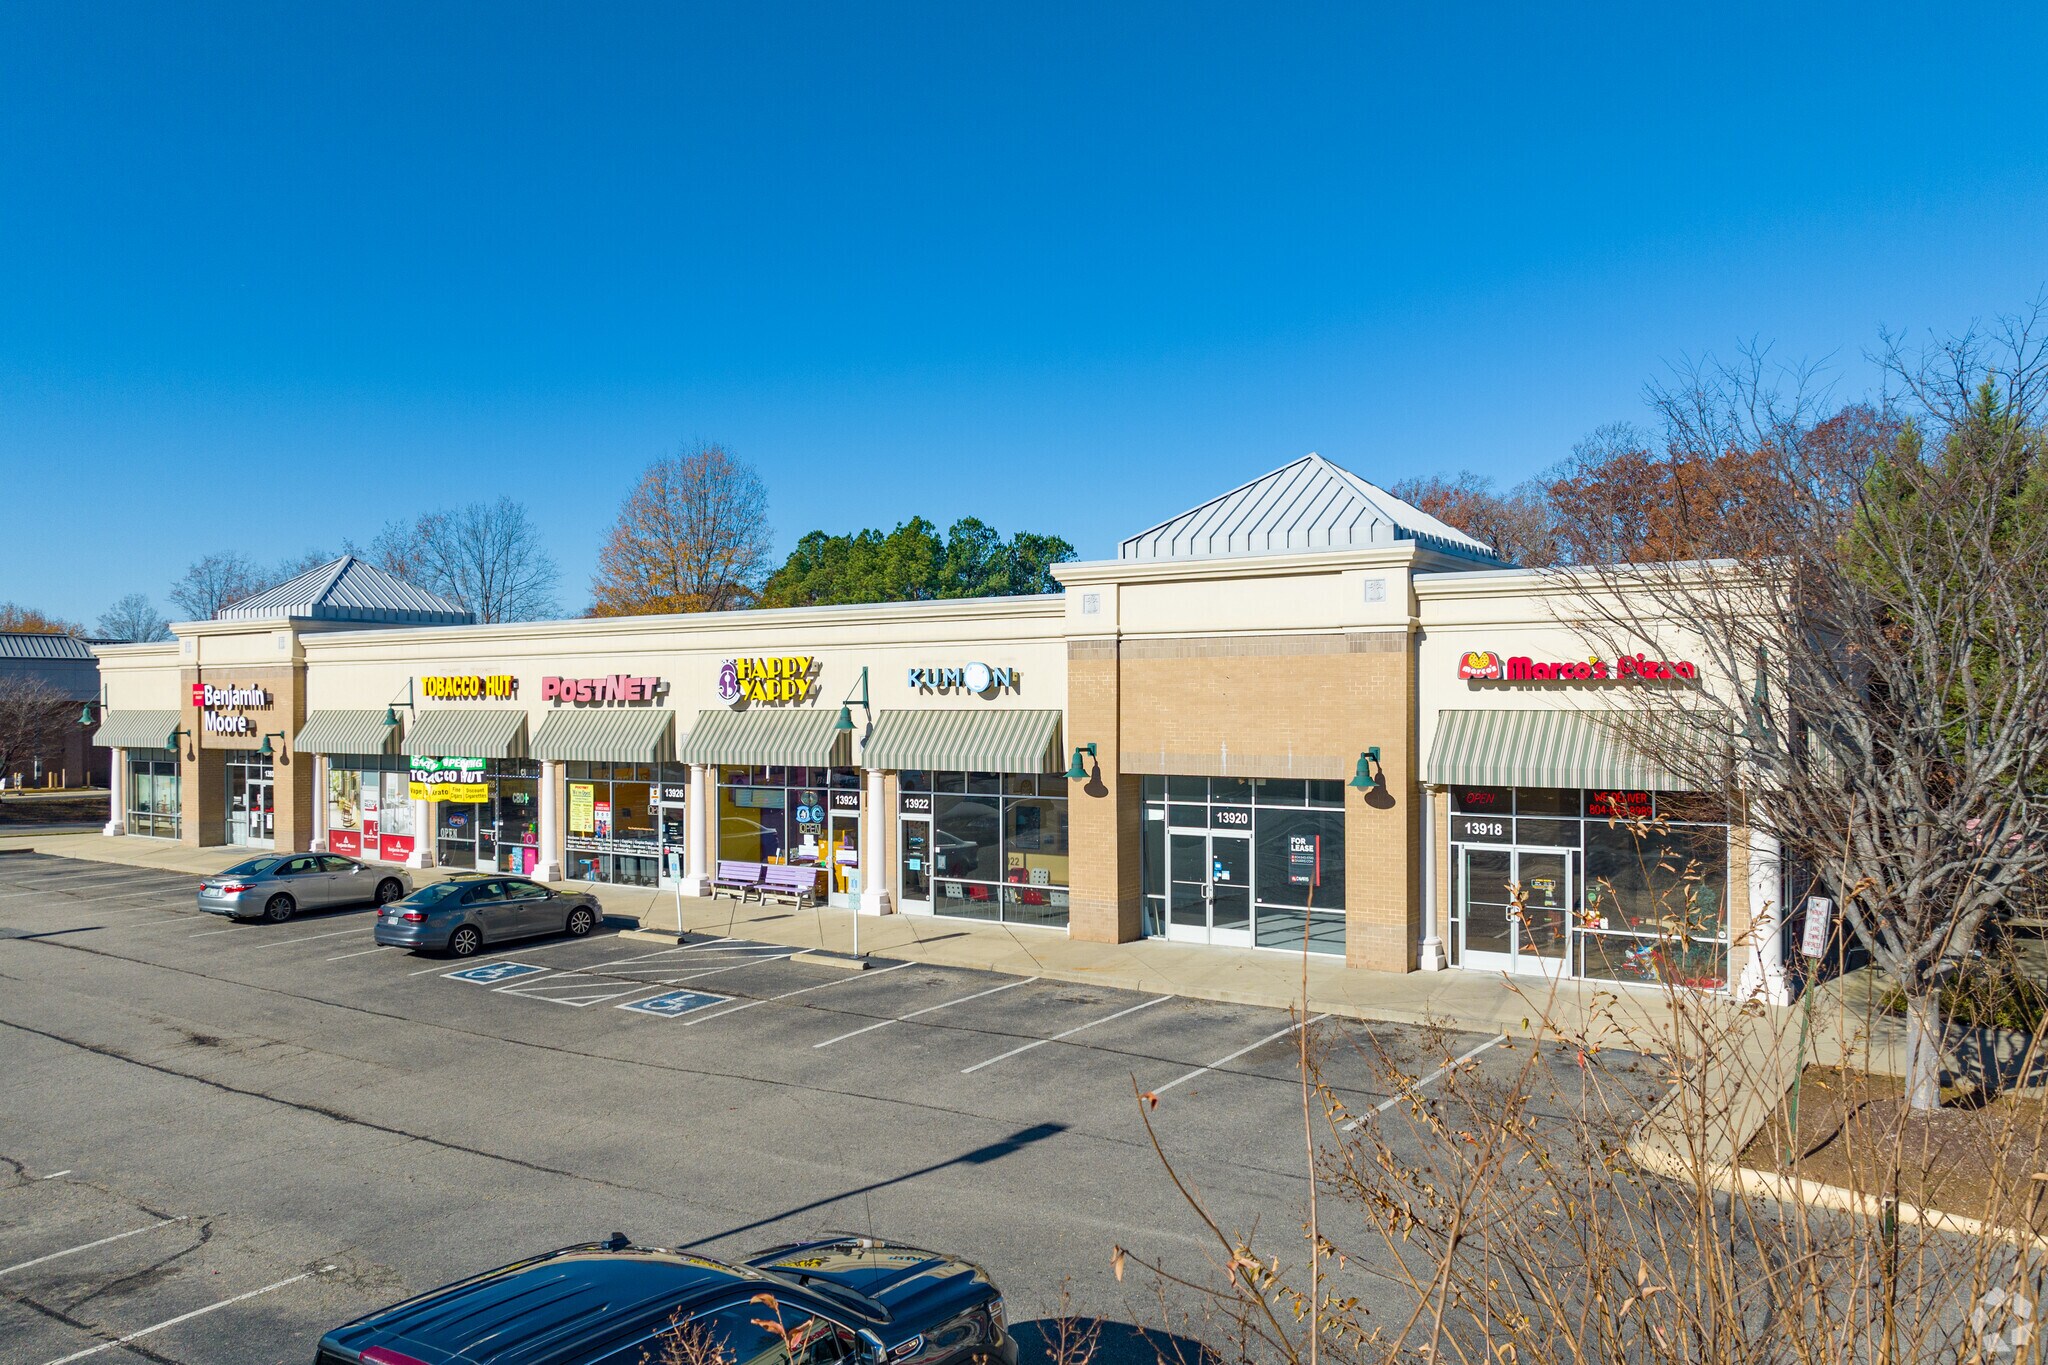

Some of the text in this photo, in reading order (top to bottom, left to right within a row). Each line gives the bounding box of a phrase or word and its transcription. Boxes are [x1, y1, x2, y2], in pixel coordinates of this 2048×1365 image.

[737, 656, 813, 678] HAPPY
[1507, 653, 1695, 680] Marco's Pizza
[908, 662, 1011, 692] KUMON
[421, 675, 513, 697] TOBACCO HUT
[739, 679, 812, 701] YAPPY
[204, 683, 265, 711] Benjamin
[205, 711, 247, 732] Moore
[460, 771, 485, 783] HUT
[664, 788, 684, 798] 13926
[1466, 793, 1495, 804] OPEN
[1593, 791, 1608, 803] WE
[835, 795, 858, 805] 13924
[905, 798, 929, 809] 13922
[1216, 812, 1248, 824] 13920
[440, 828, 458, 838] OPEN
[800, 823, 821, 834] OPEN
[1465, 822, 1503, 836] 13918
[1290, 837, 1306, 845] FOR
